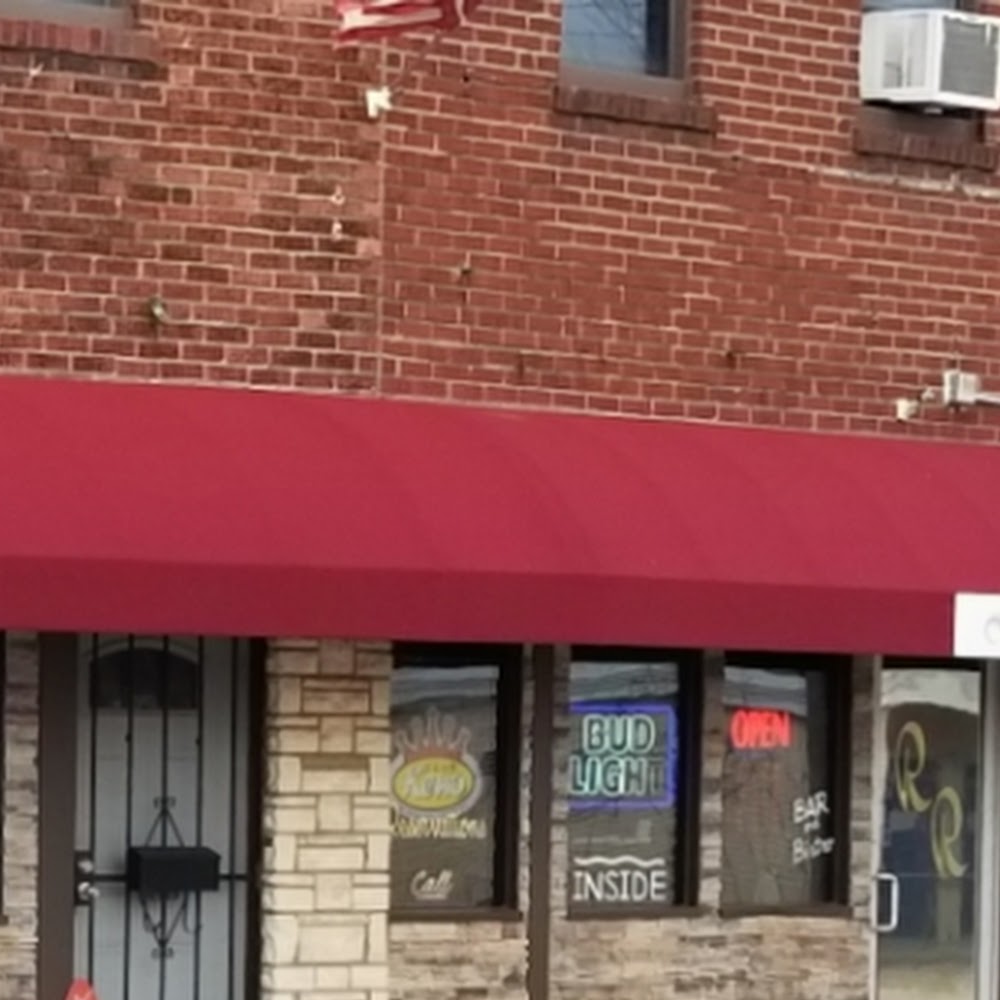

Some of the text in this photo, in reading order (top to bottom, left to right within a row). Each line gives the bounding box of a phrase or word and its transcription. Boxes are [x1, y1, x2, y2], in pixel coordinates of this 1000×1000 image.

[583, 714, 656, 755] BUD
[730, 709, 791, 749] OPEN
[569, 755, 665, 796] LIGHT
[793, 790, 830, 824] BAR
[573, 869, 667, 901] INSIDE
